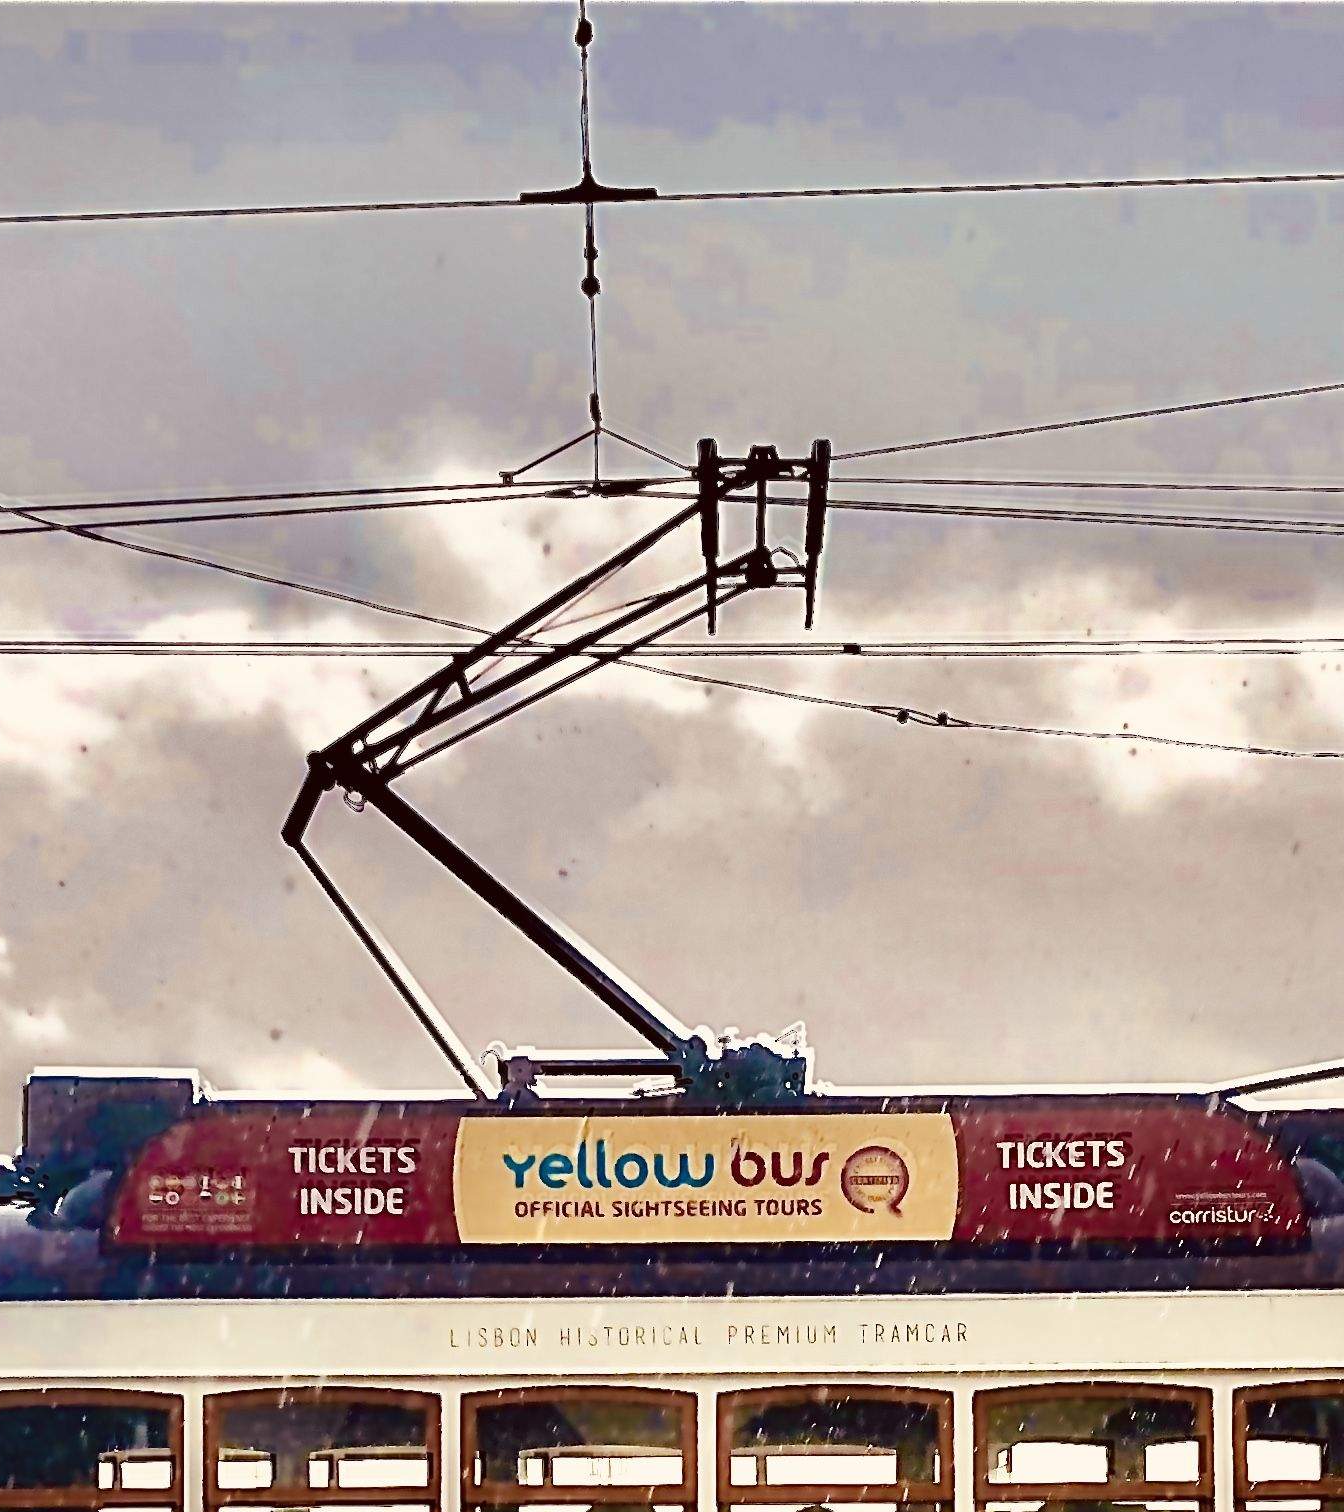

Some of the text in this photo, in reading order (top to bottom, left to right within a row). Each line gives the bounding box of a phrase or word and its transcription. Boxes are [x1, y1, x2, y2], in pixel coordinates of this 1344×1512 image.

[287, 1146, 417, 1174] TICKETS
[502, 1138, 830, 1189] yellow bus
[996, 1140, 1125, 1169] TICKETS
[300, 1187, 404, 1215] INSIDE
[514, 1198, 823, 1218] OFFICIAL SIGHTSEEING TOURS
[1009, 1181, 1114, 1210] INSIDE
[1169, 1206, 1257, 1224] carristur
[450, 1322, 968, 1348] LISBON HISTORICAL PREMIUM TRAMCAR
